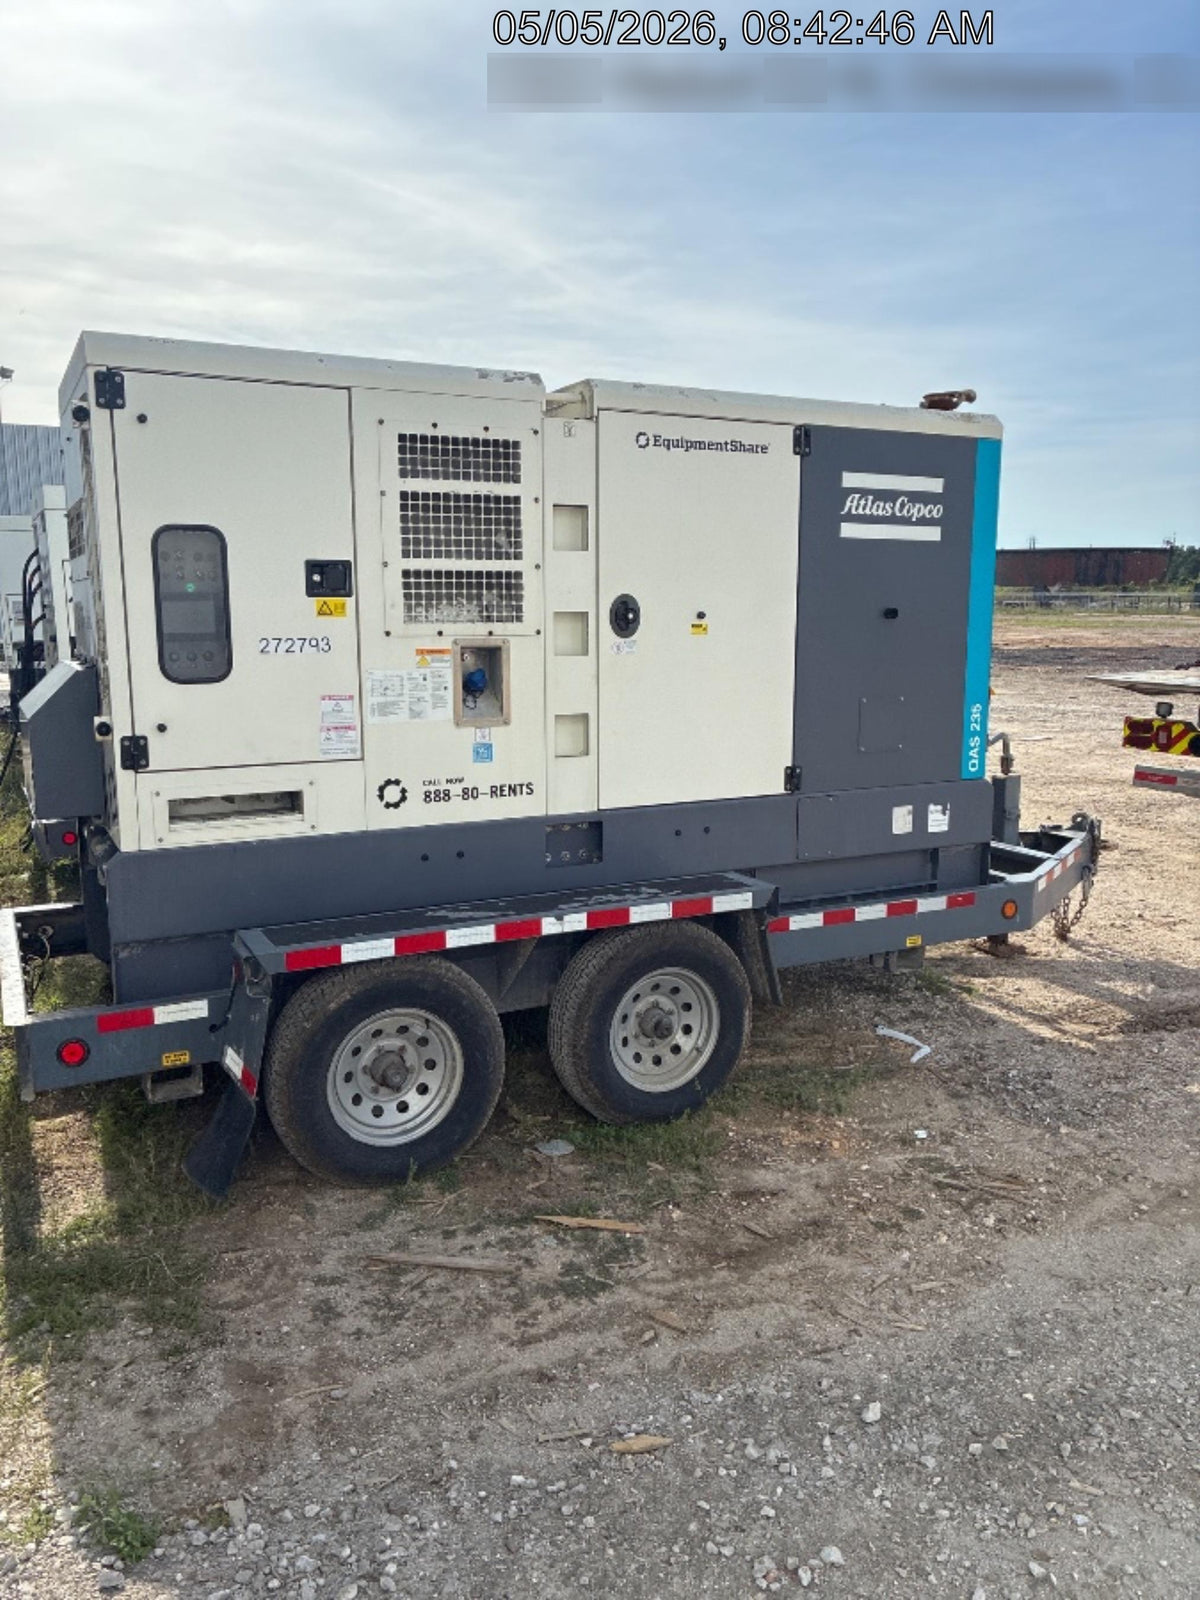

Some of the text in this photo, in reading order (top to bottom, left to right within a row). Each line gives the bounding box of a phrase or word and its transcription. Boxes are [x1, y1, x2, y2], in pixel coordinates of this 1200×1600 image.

[652, 434, 769, 454] EquipmentShare
[840, 493, 943, 522] Atlas Copco
[259, 636, 332, 654] 272793
[422, 776, 465, 787] CALL NOW
[423, 781, 535, 804] 888-80-RENTS
